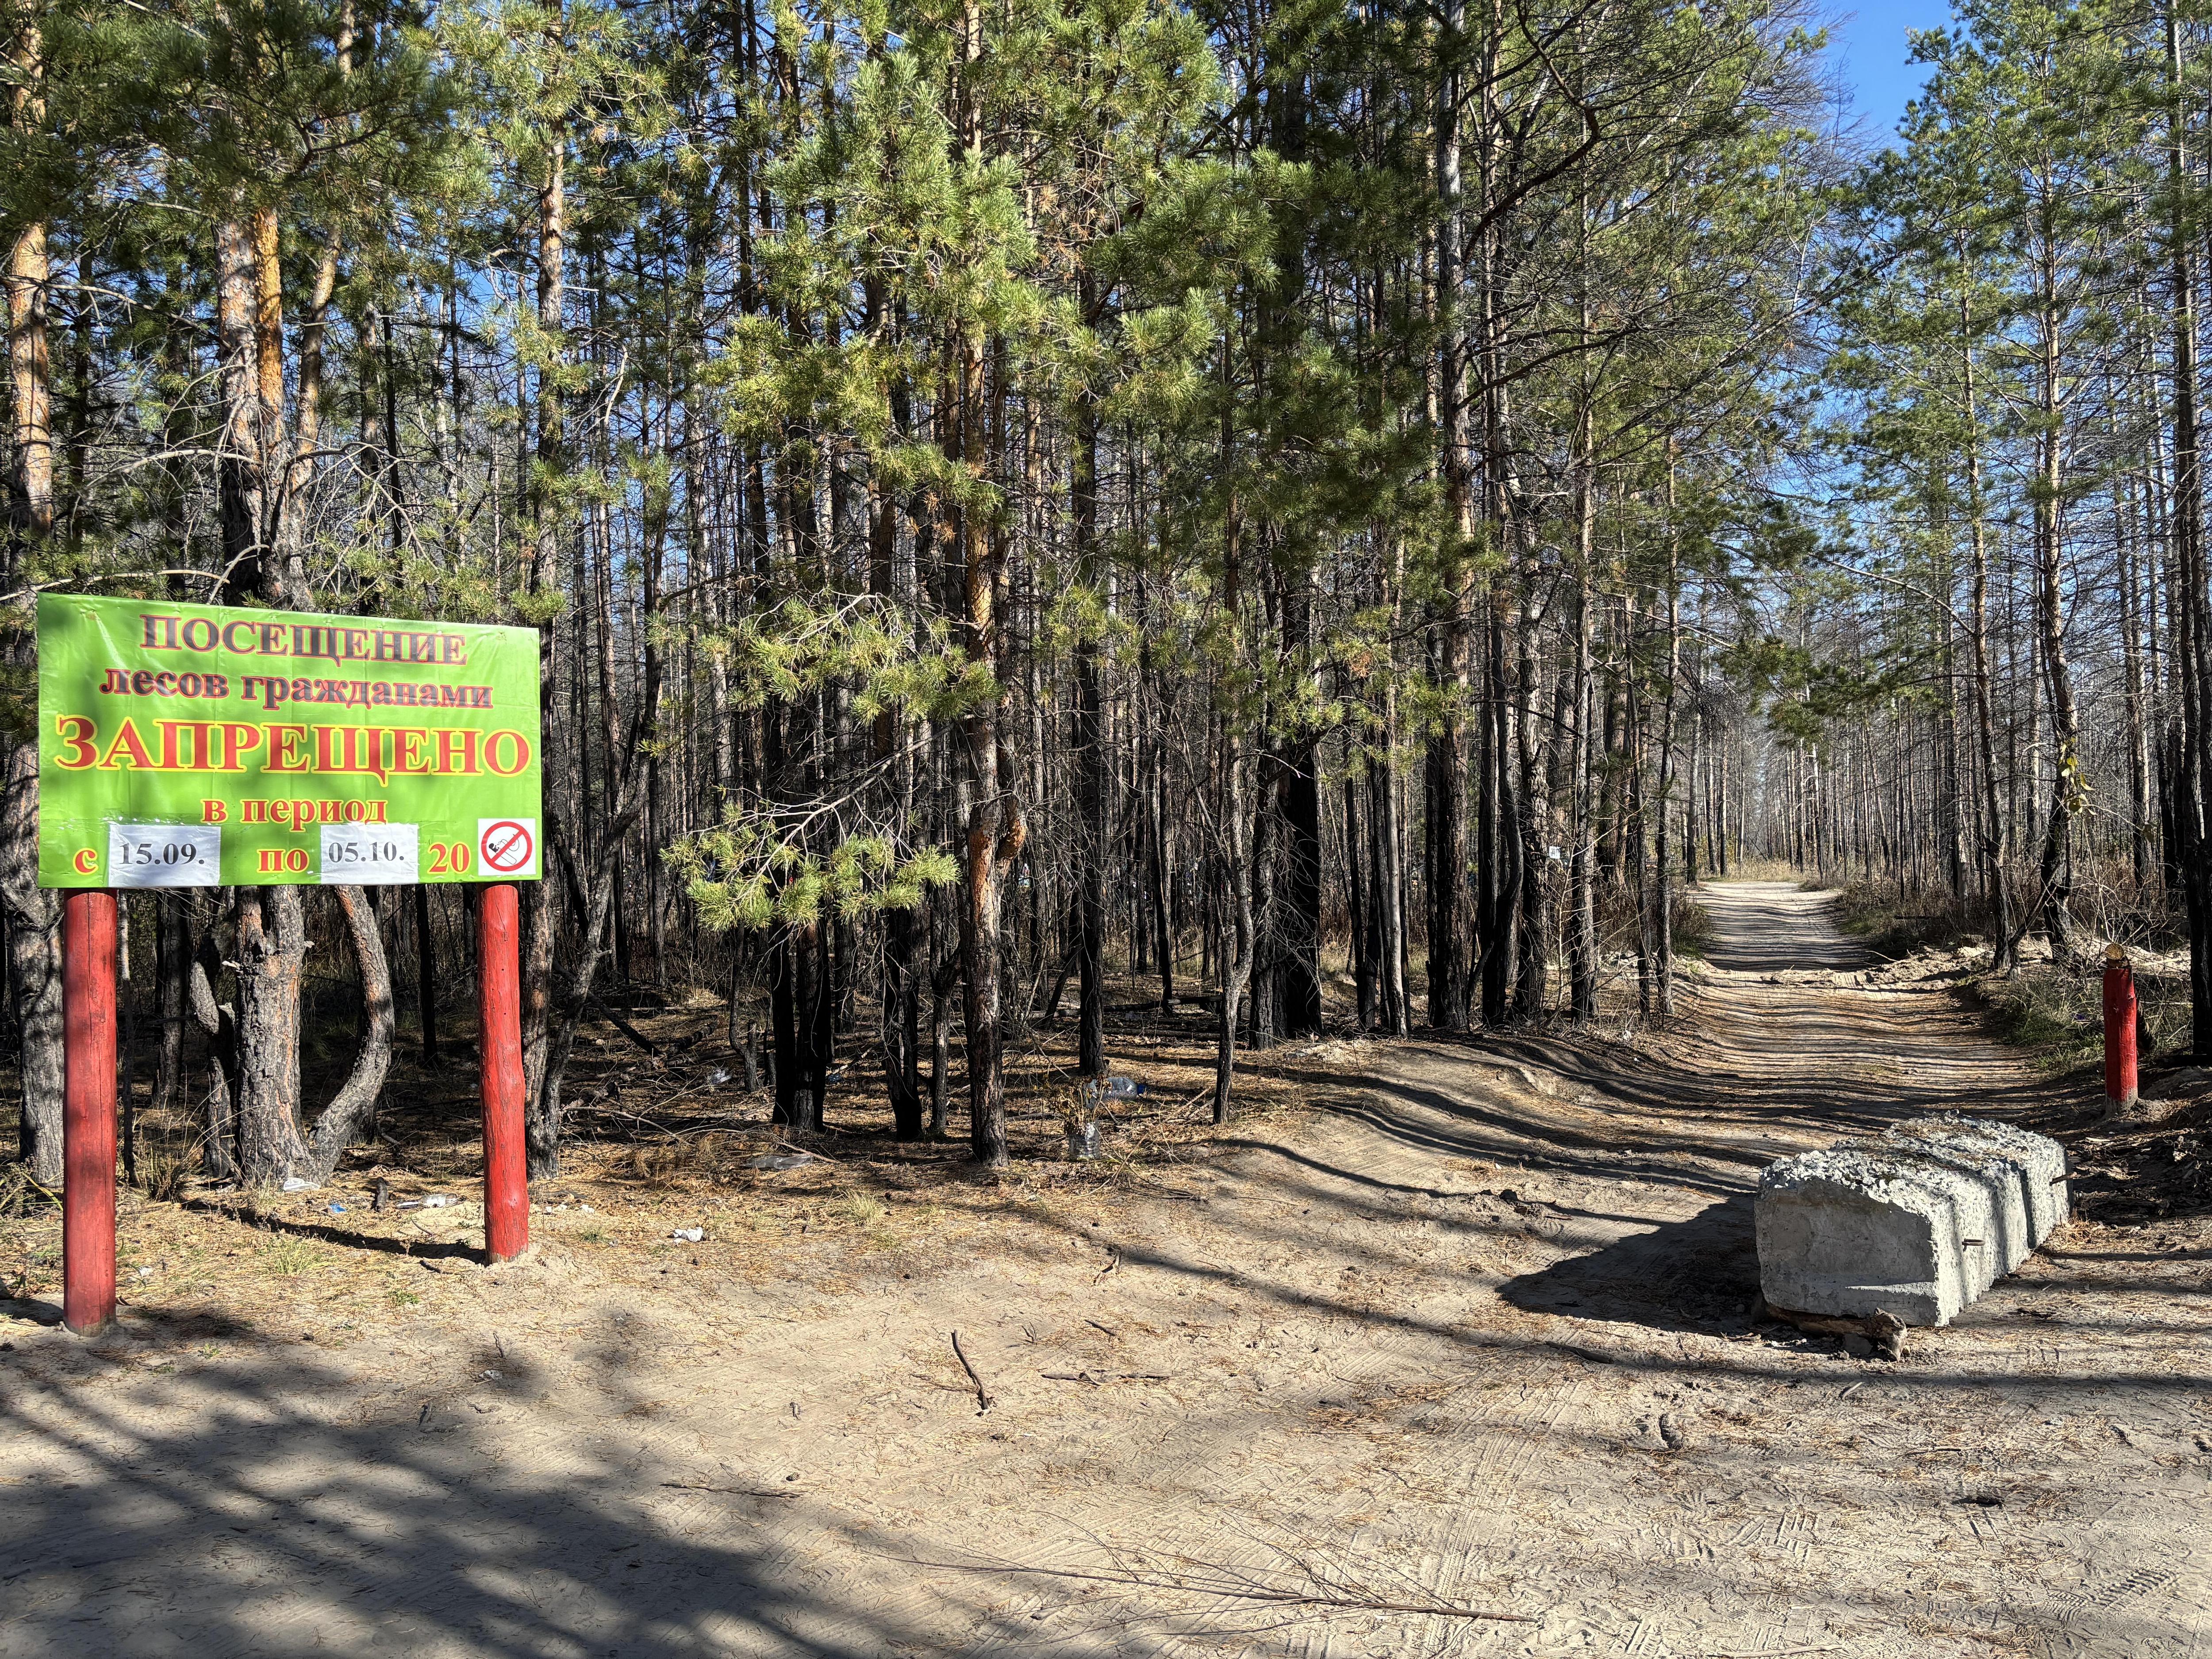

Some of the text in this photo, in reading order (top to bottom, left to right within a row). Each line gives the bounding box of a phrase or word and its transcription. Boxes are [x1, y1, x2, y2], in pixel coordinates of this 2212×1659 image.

[139, 614, 467, 667] ПОСЕЩЕНИЕ
[100, 668, 494, 710] лесов гражданами
[54, 714, 533, 787] ЗАПРЕЩЕНО
[201, 799, 387, 832] в период
[73, 841, 470, 875] с 15.09. по 05.10. 20
